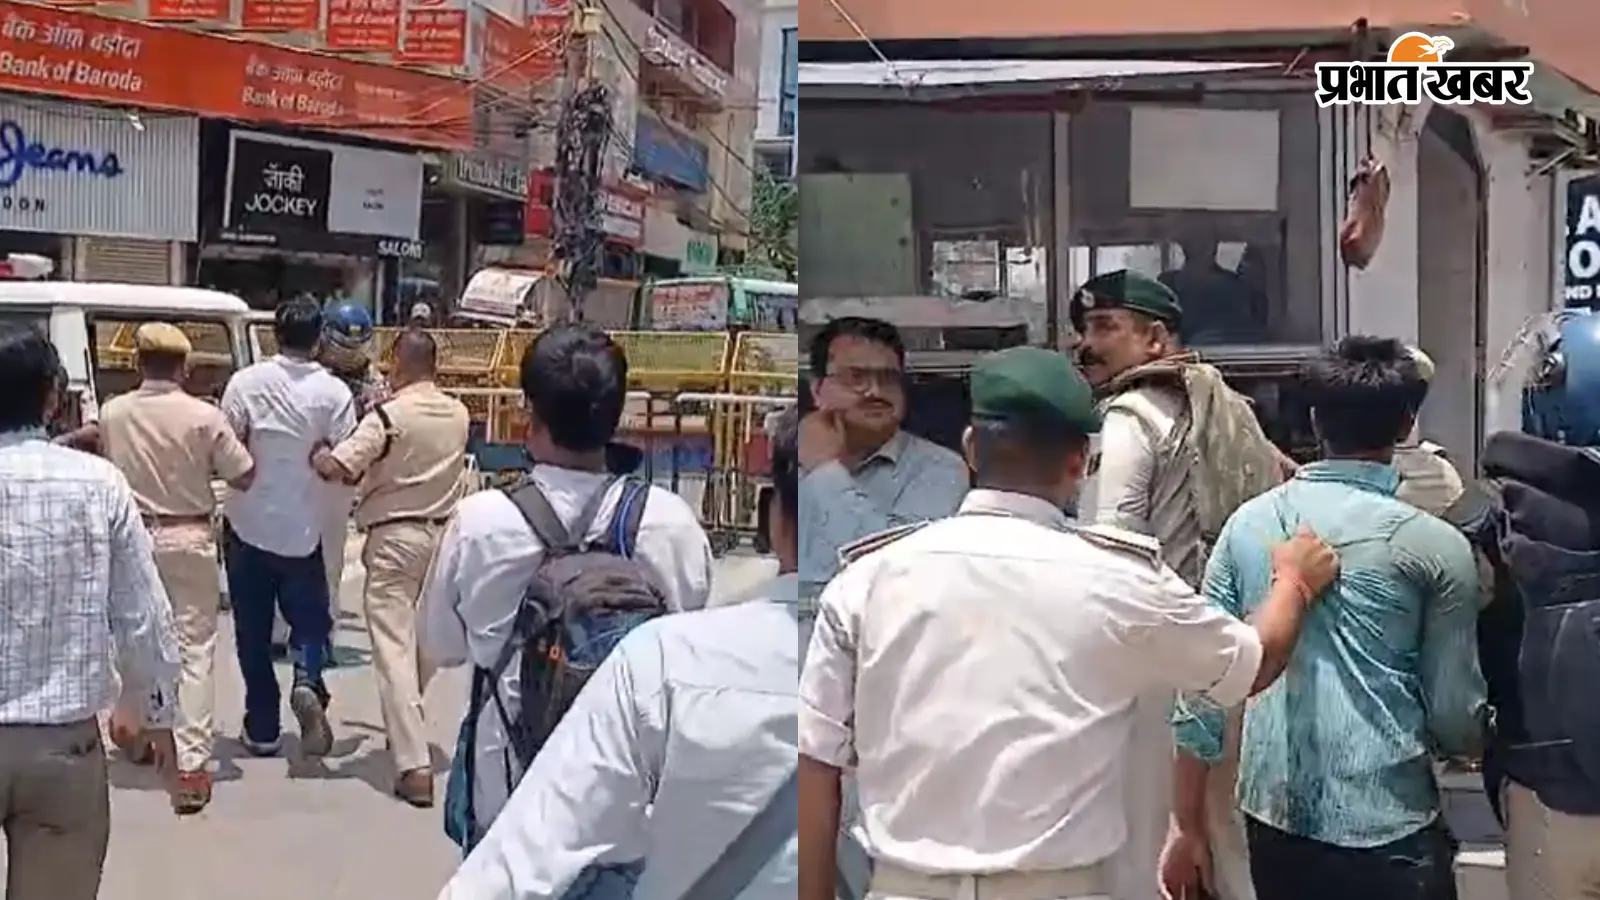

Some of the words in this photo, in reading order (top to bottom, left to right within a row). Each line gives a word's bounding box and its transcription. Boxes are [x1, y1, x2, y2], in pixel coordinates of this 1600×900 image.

[0, 51, 49, 79] Bank
[53, 60, 75, 84] of
[74, 62, 142, 91] Baroda
[242, 86, 277, 108] Bank
[280, 92, 295, 110] of
[0, 121, 123, 187] Jeans
[262, 161, 306, 193] जॉकी
[245, 193, 317, 217] JOCKEY
